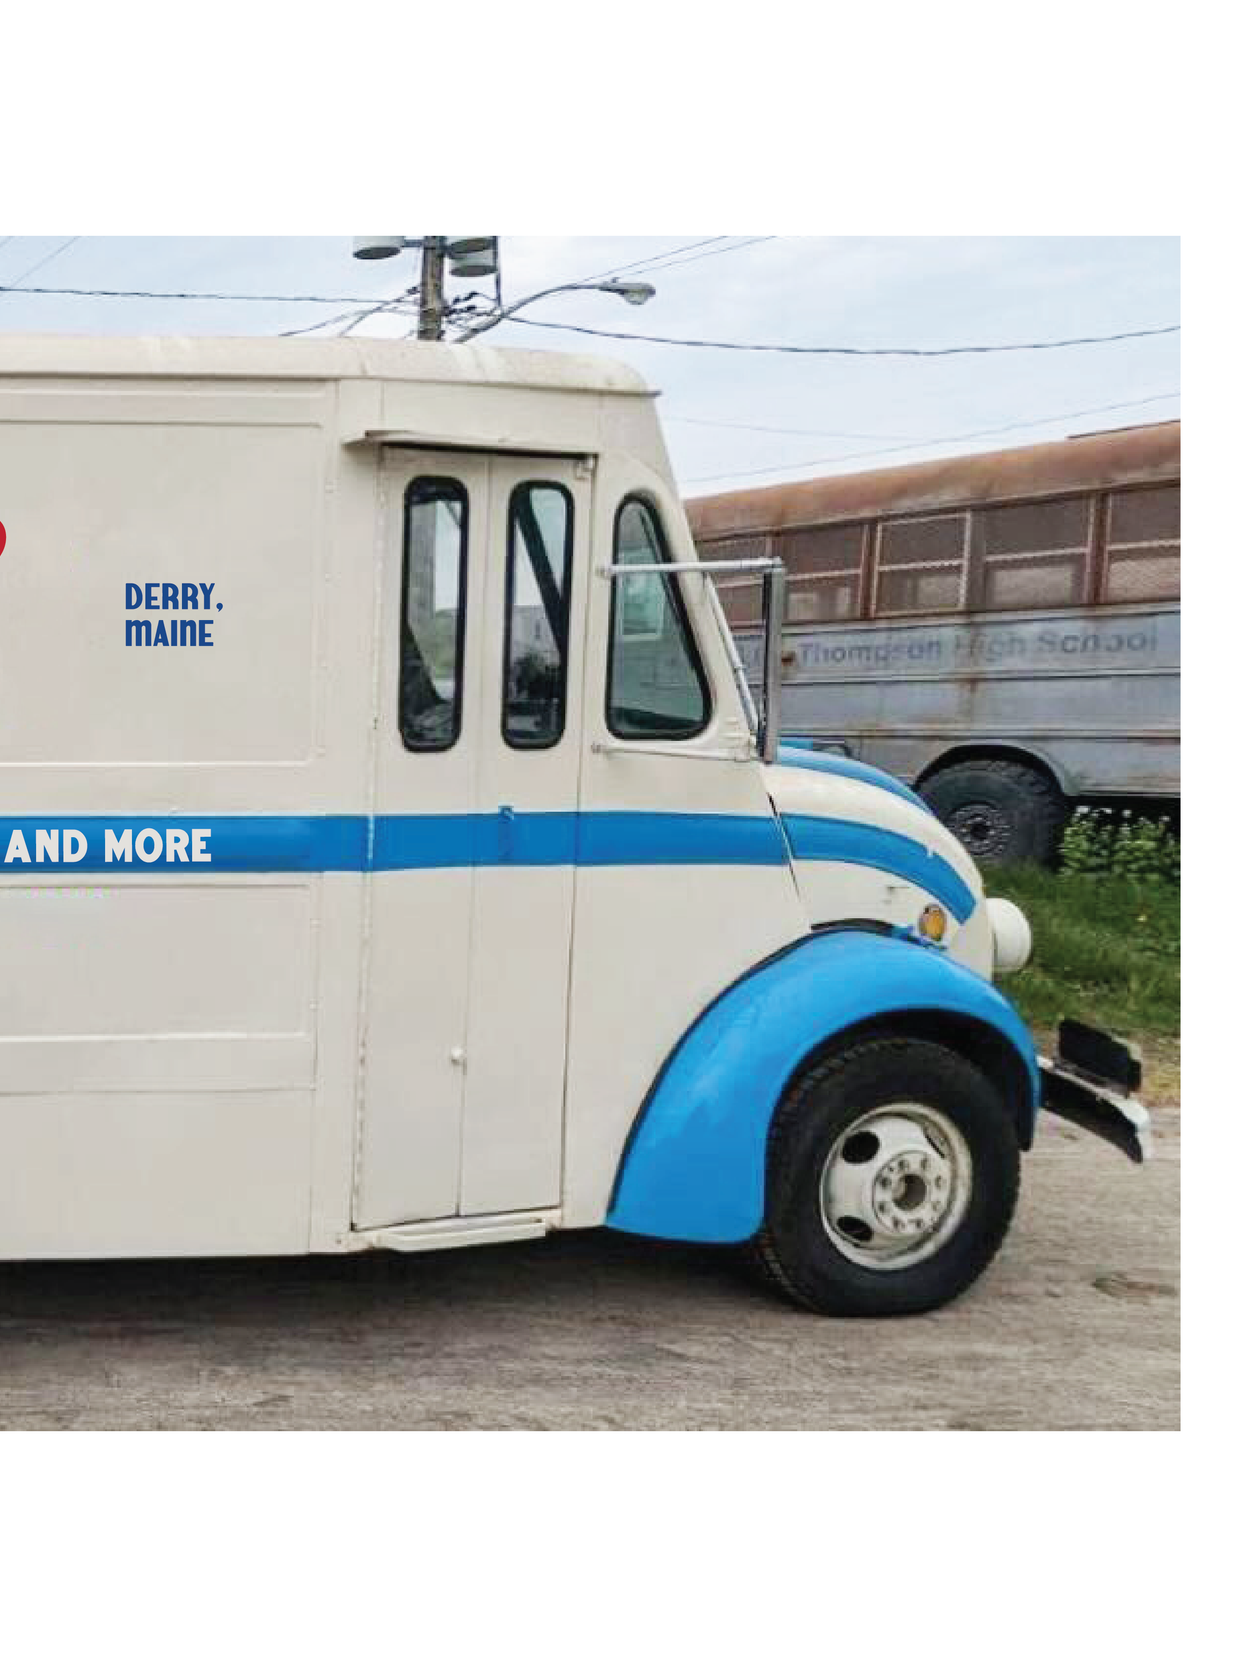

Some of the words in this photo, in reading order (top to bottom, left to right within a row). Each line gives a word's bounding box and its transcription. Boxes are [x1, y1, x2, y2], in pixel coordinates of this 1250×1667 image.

[125, 582, 224, 612] DERRY,
[125, 619, 214, 647] MAINE
[4, 829, 88, 863] AND
[104, 828, 212, 863] MORE
